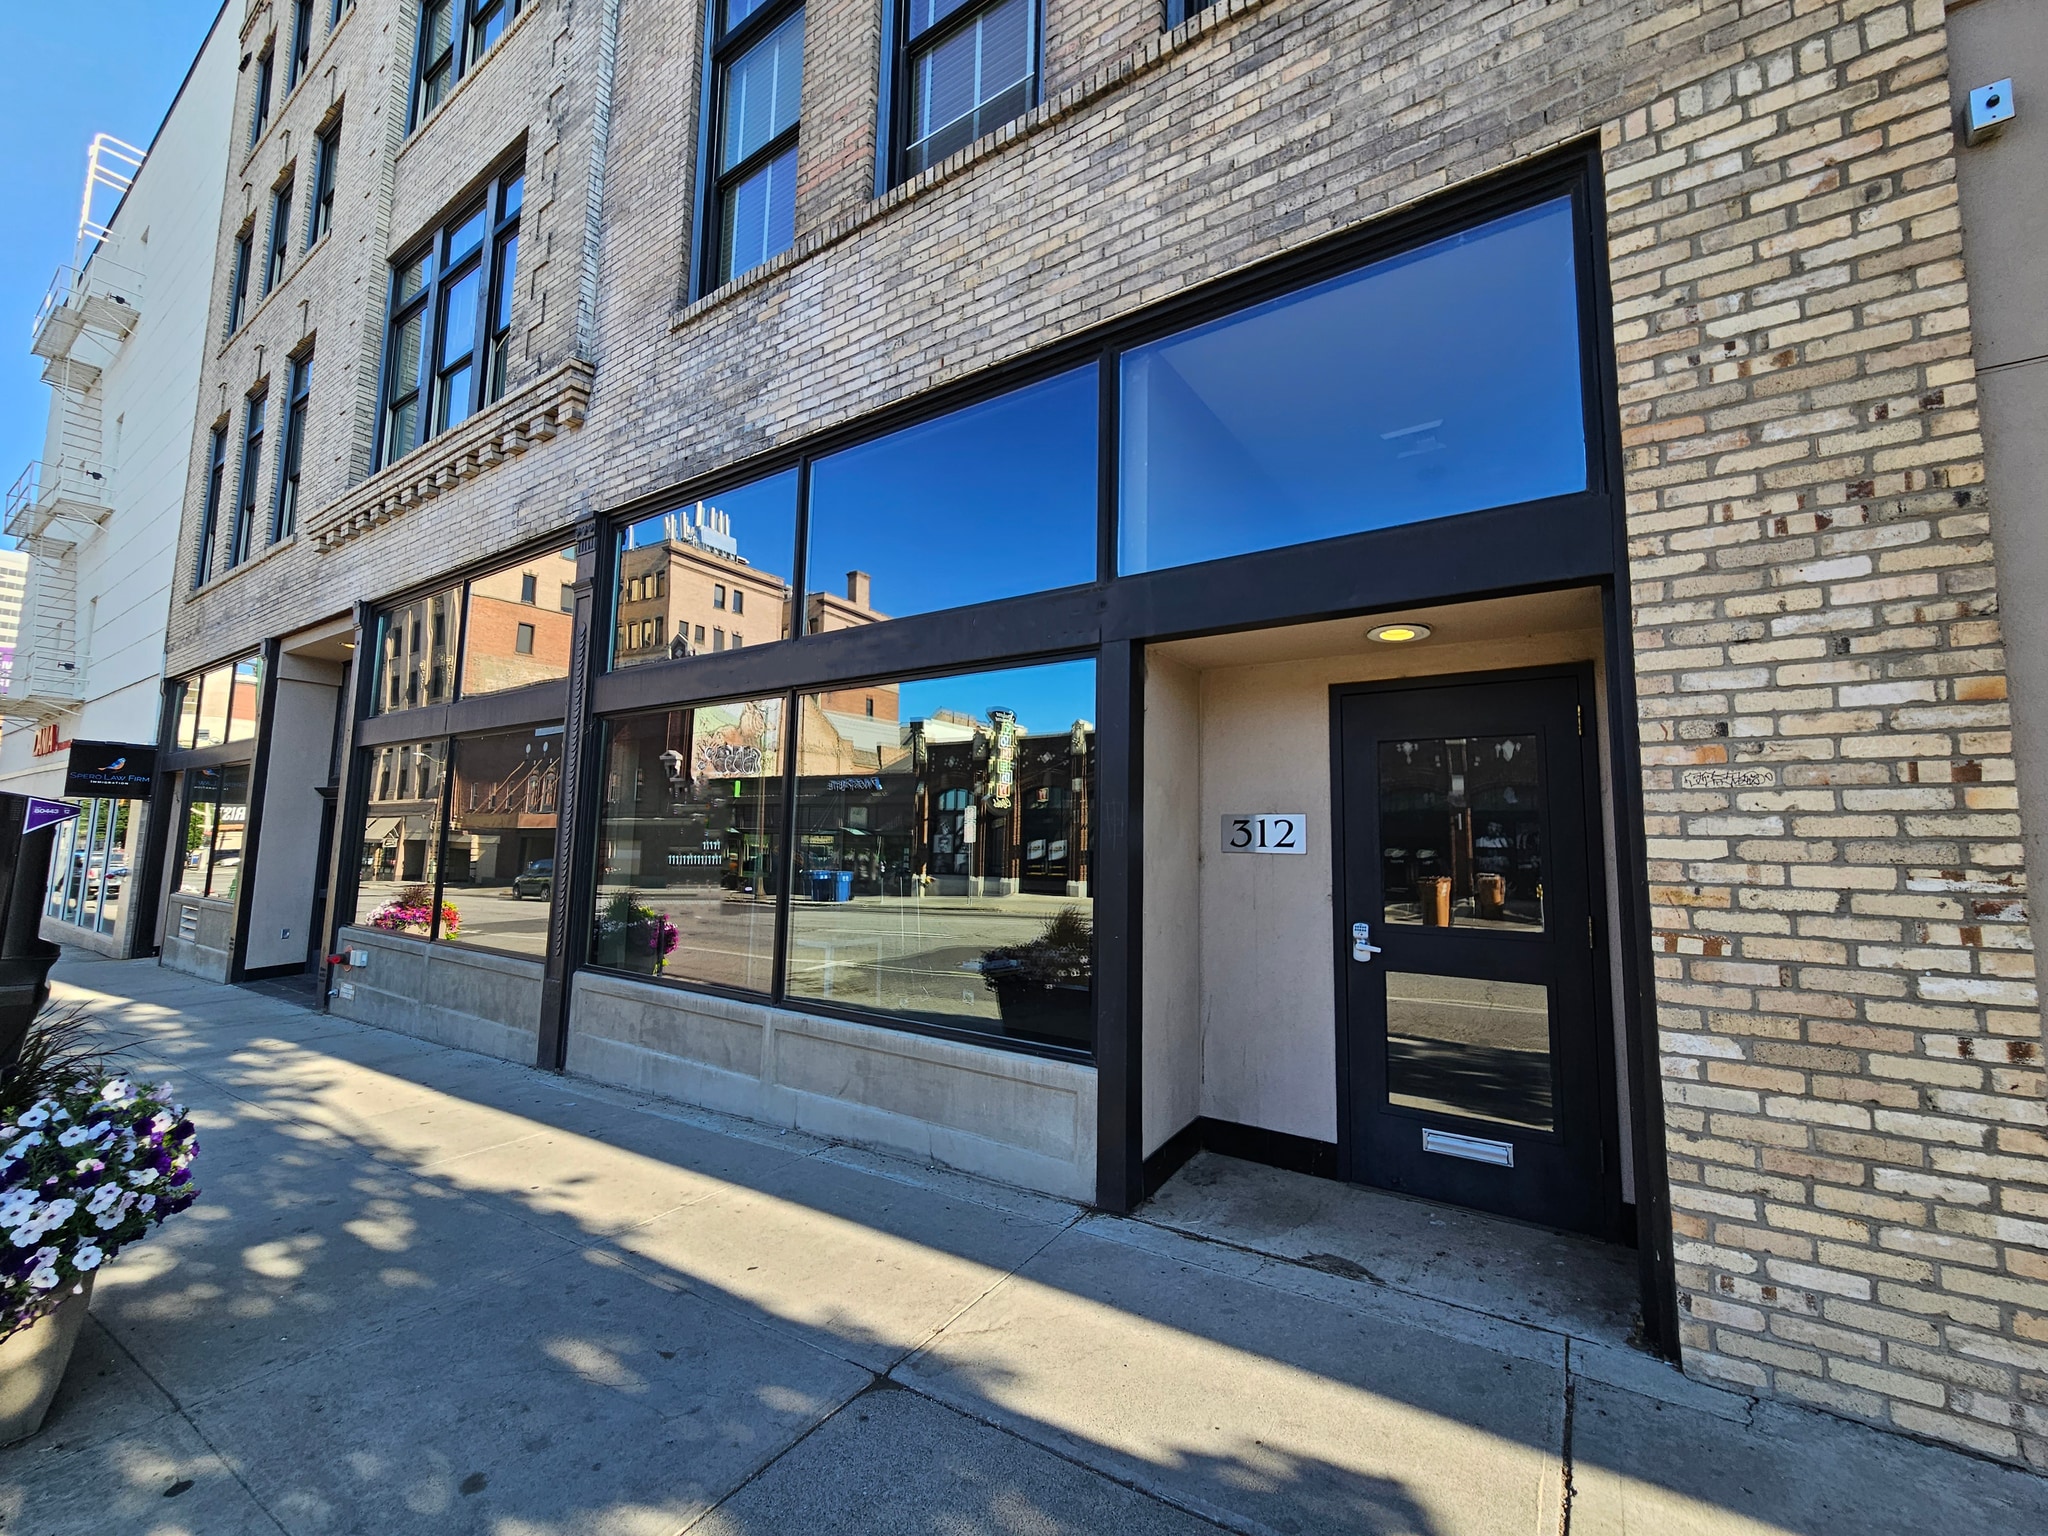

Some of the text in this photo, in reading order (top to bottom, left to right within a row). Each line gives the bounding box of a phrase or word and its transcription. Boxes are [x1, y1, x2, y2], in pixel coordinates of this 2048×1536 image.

[104, 773, 126, 781] LAW
[128, 774, 150, 783] FIRM
[1230, 819, 1296, 848] 312
